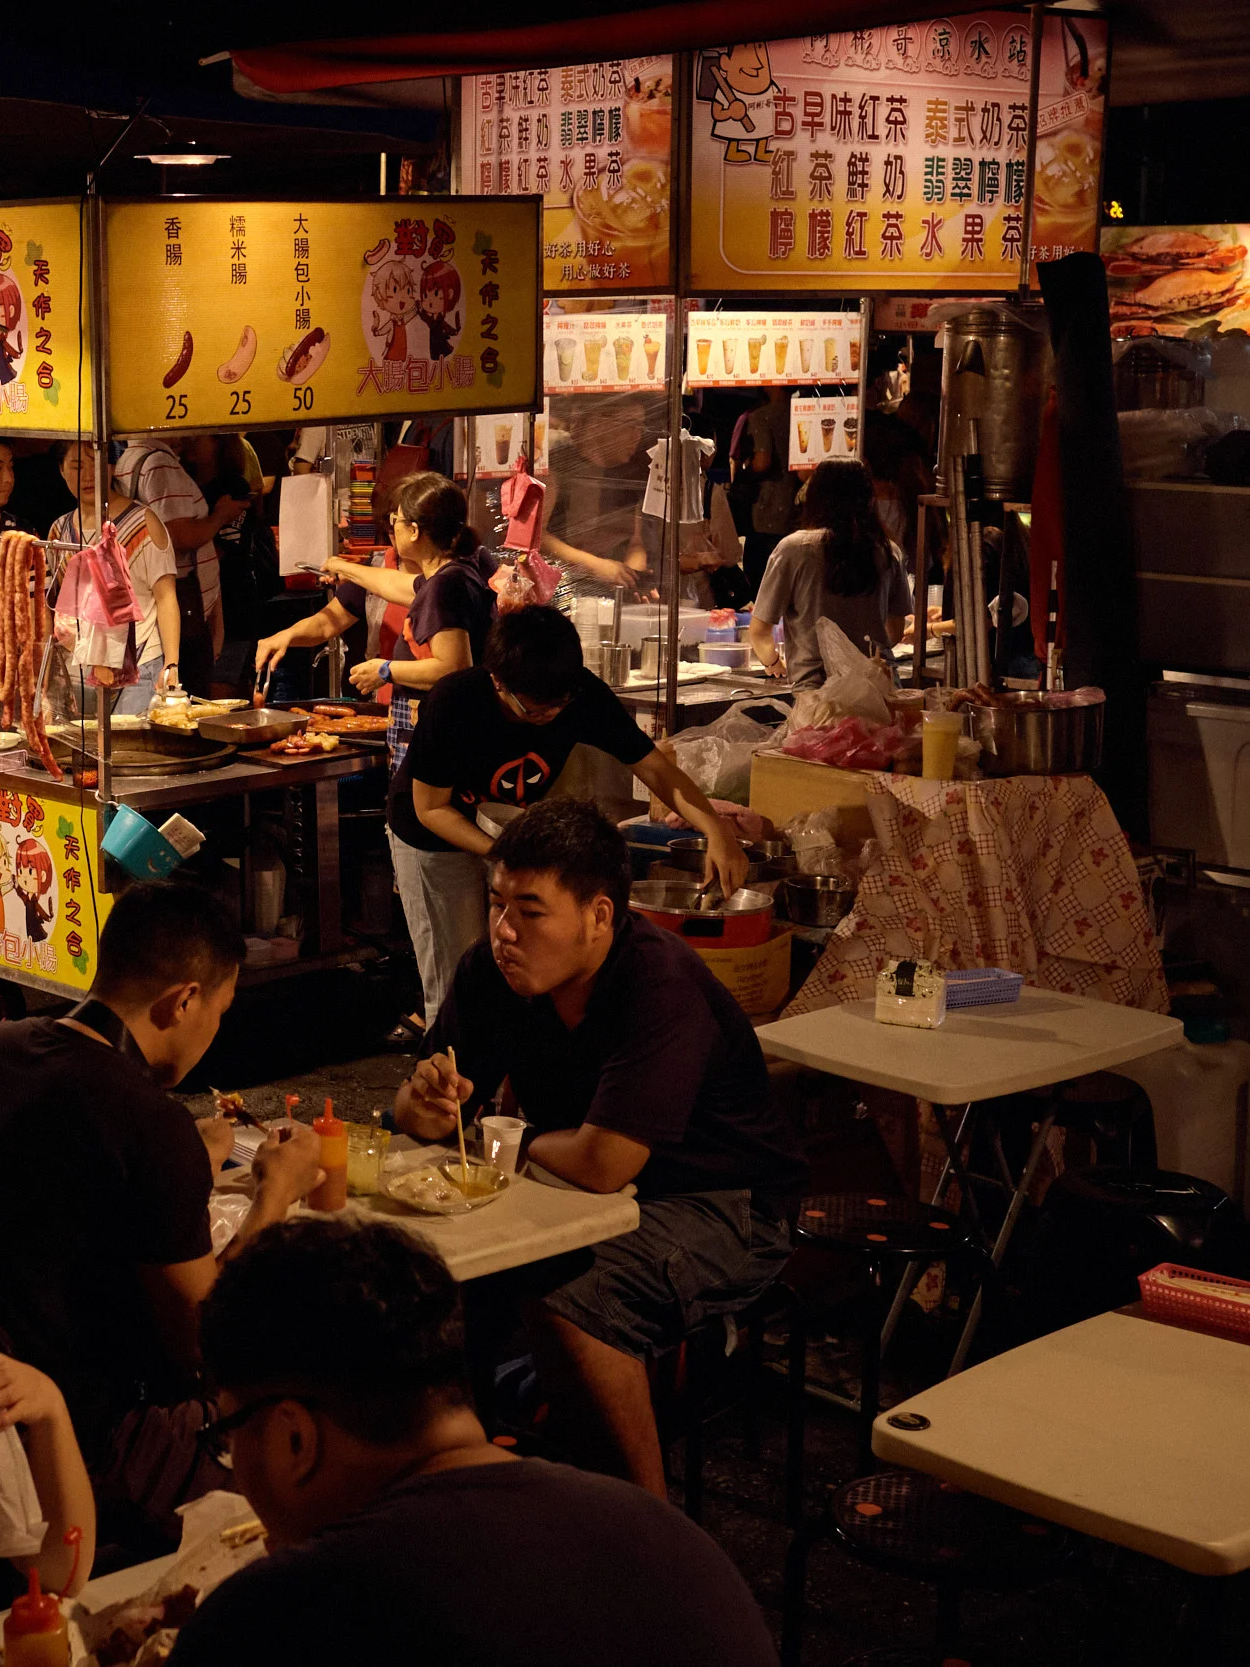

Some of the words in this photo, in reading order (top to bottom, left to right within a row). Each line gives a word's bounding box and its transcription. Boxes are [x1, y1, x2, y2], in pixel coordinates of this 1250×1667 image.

[480, 113, 549, 155] 紅茶鮮奶
[773, 88, 908, 143] 古早味紅茶
[925, 98, 1029, 148] 泰式奶茶
[560, 150, 621, 191] 水果茶
[771, 148, 907, 202] 紅茶鮮奶
[923, 156, 1026, 204] 翡翠檸檬
[164, 217, 183, 266] 香腸
[230, 215, 247, 285] 糯米腸
[545, 240, 615, 258] 好茶用好心
[768, 208, 905, 260] 檸檬紅茶
[920, 212, 1023, 260] 水果茶
[293, 213, 311, 330] 大腸包小腸
[32, 259, 54, 389] 天作之合
[479, 249, 500, 374] 天作之合
[357, 355, 476, 396] 大腸包小腸
[166, 394, 188, 420] 25
[230, 390, 252, 416] 25
[292, 386, 314, 411] 50
[63, 835, 83, 957] 天作之合
